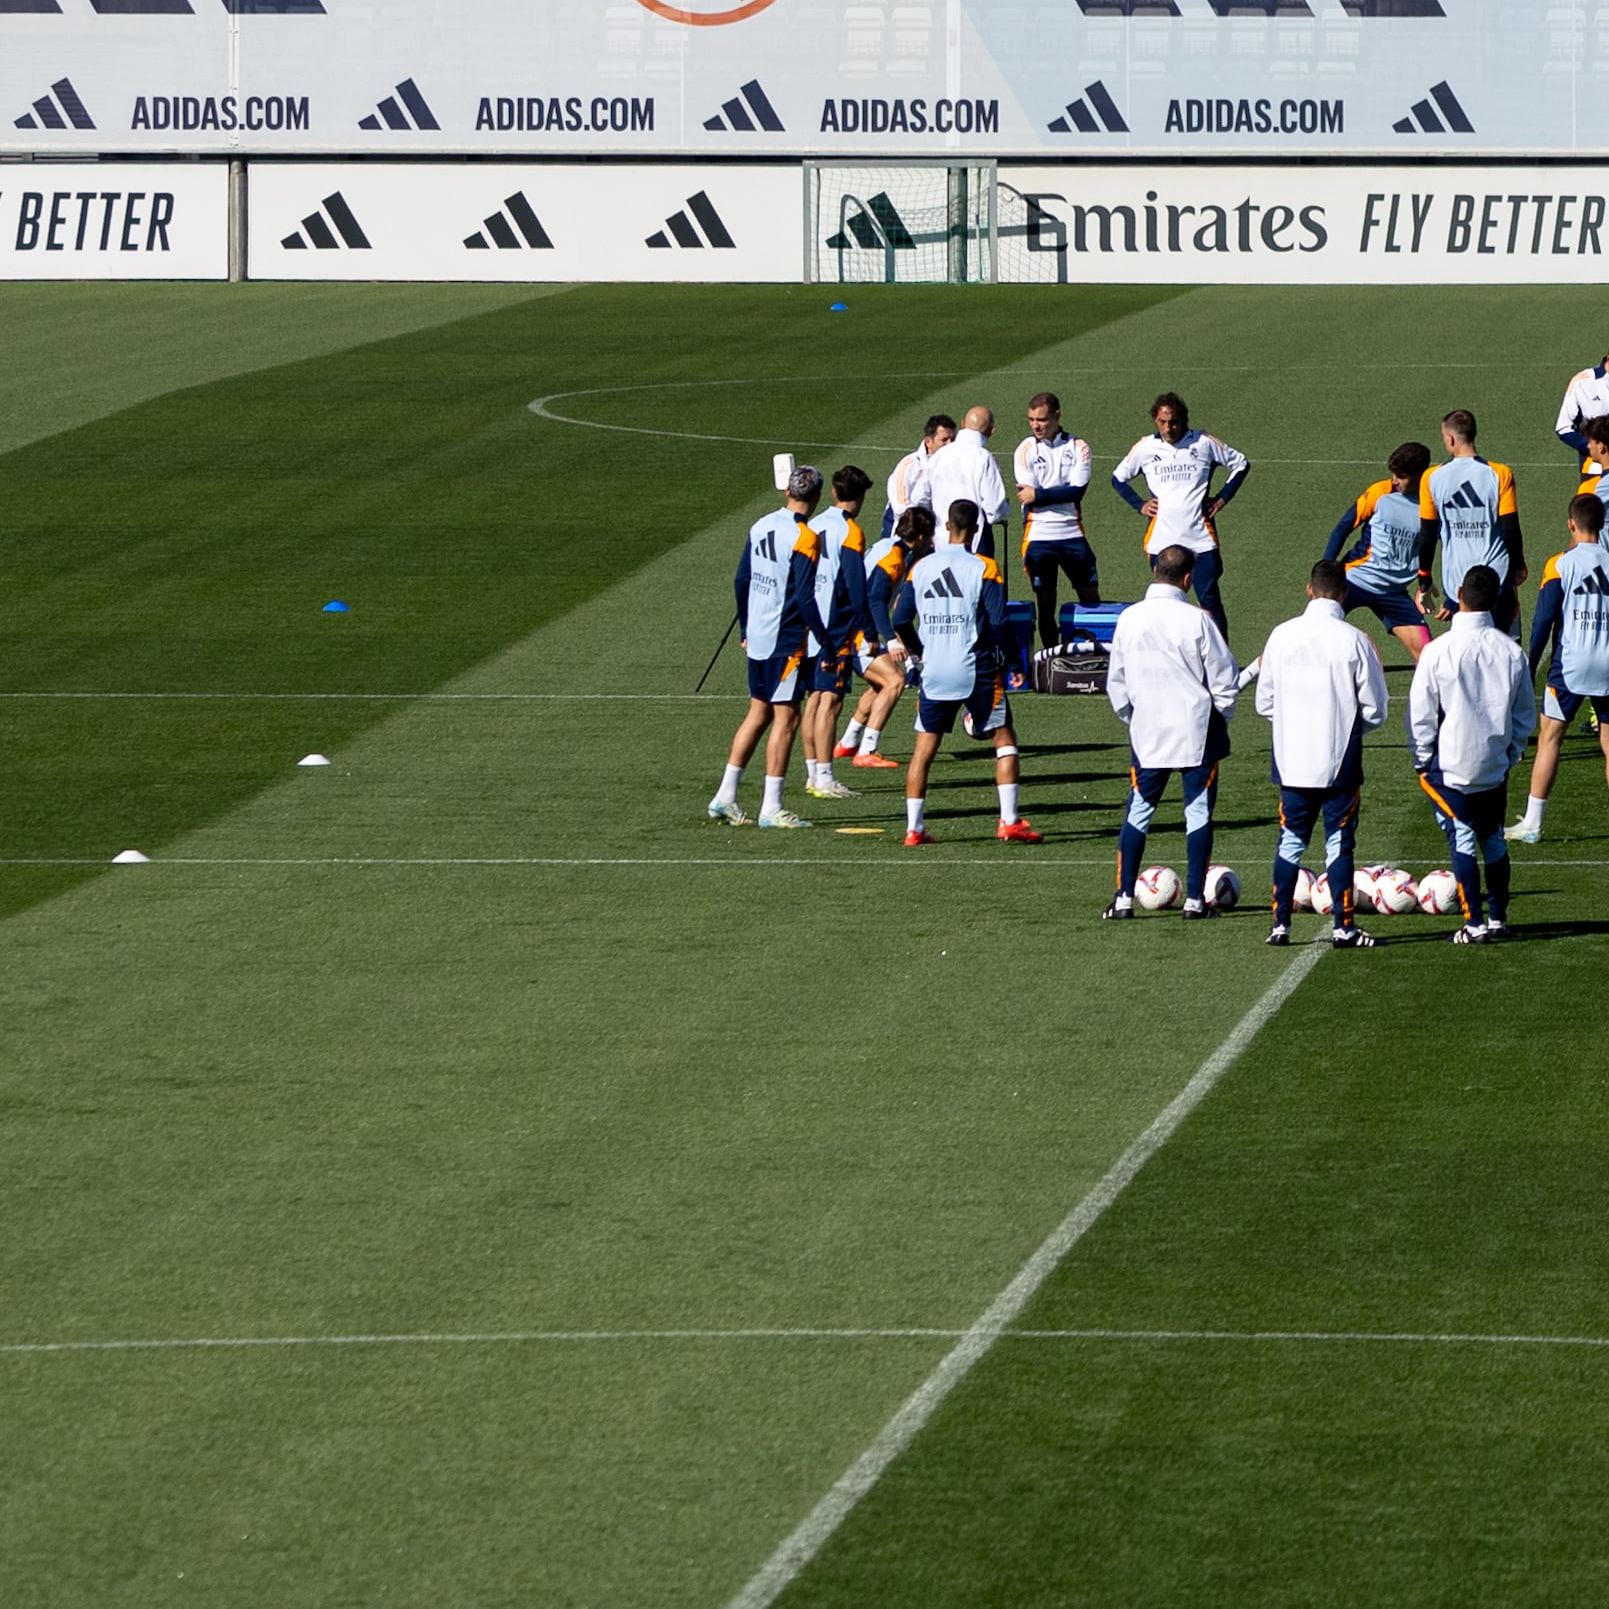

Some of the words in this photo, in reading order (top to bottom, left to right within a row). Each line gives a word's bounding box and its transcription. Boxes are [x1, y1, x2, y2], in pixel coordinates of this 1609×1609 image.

[132, 97, 310, 132] ADIDAS.COM
[476, 98, 655, 133] ADIDAS.COM
[821, 99, 999, 134] ADIDAS.COM
[1166, 99, 1345, 135] ADIDAS.COM
[16, 193, 174, 252] BETTER
[1023, 191, 1328, 253] Emirates
[1360, 194, 1435, 254] FLY
[1447, 195, 1607, 255] BETTER
[1154, 463, 1198, 475] Emirates
[923, 612, 965, 624] Emirates
